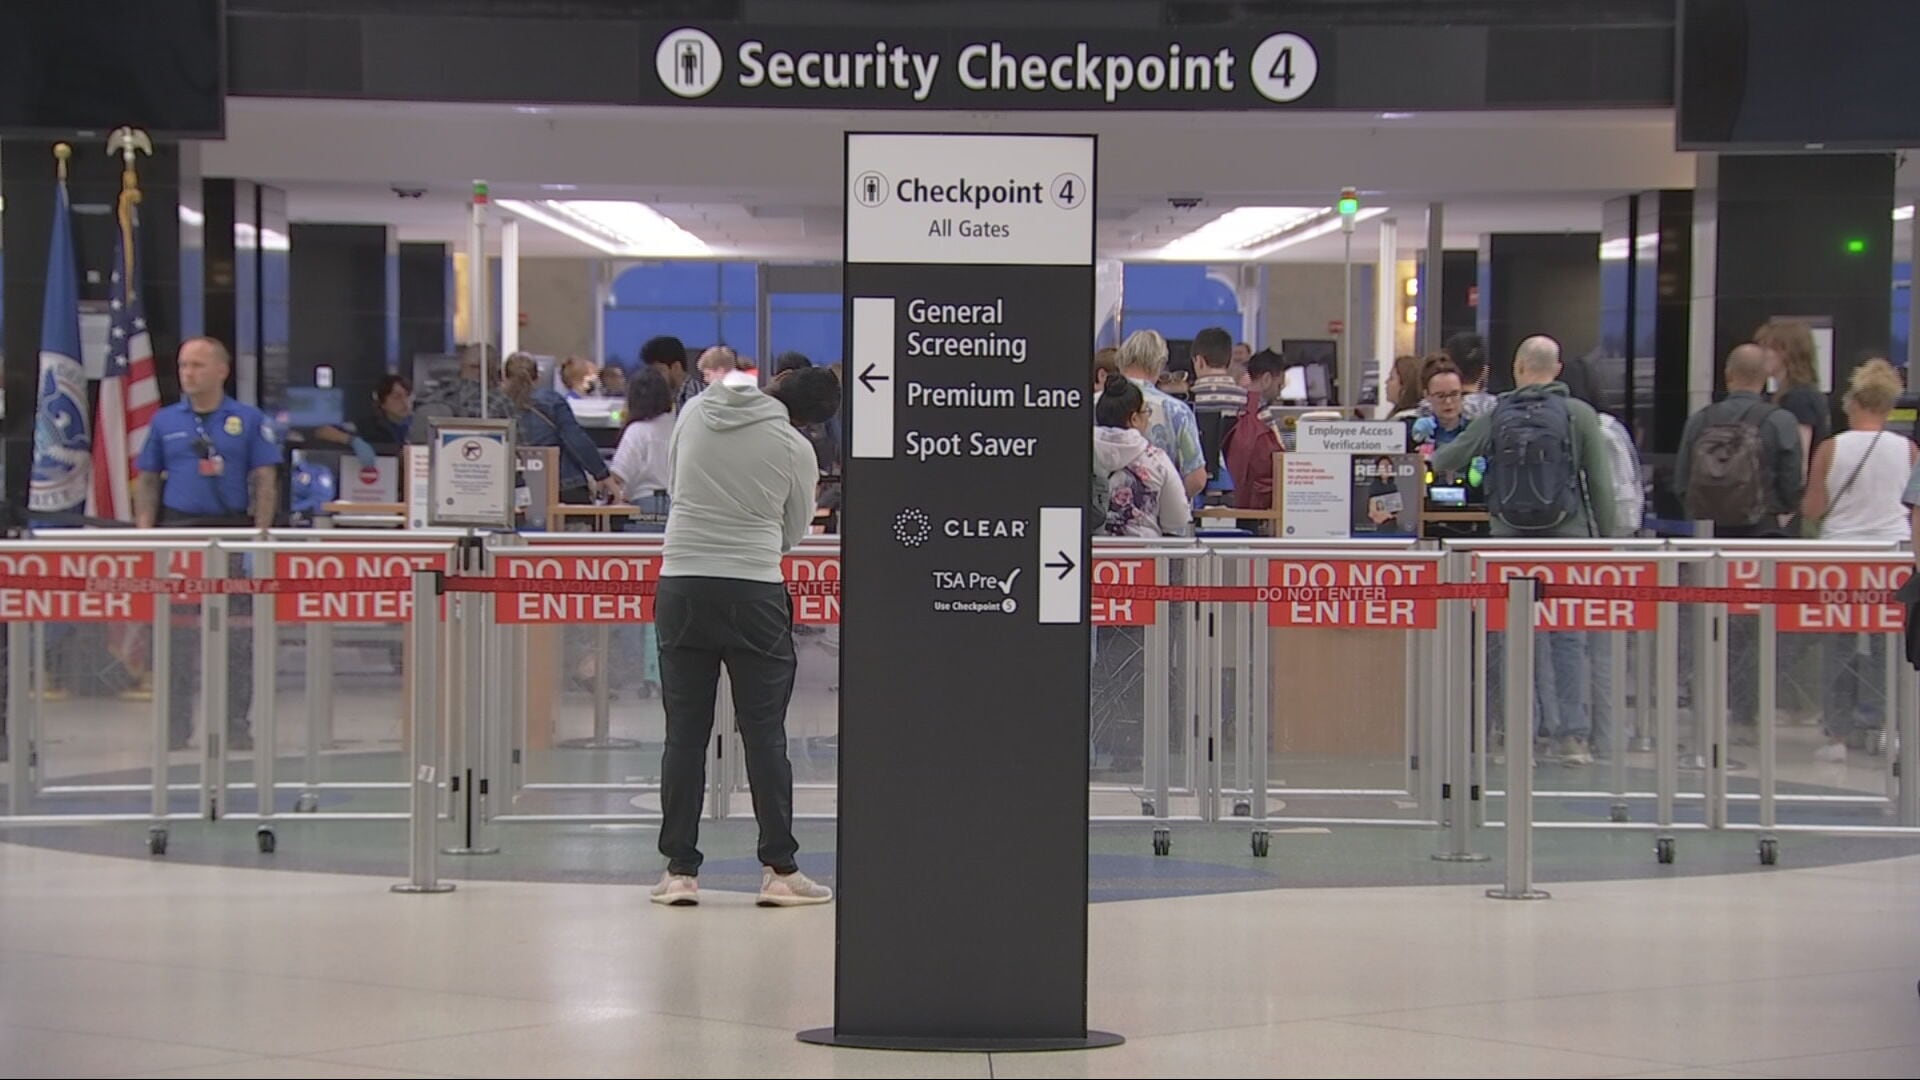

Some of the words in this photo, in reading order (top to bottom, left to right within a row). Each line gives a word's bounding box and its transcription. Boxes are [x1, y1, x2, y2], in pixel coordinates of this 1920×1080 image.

[738, 41, 939, 100] Security
[957, 44, 1234, 102] Checkpoint
[1268, 47, 1295, 88] 4
[896, 178, 1043, 209] Checkpoint
[1058, 179, 1075, 204] 4
[928, 219, 951, 237] All
[958, 219, 1010, 238] Gates
[908, 299, 1003, 324] General
[907, 332, 1027, 363] Screening
[907, 383, 1015, 407] Premium
[1024, 384, 1081, 408] Lane
[1308, 425, 1357, 437] Employee
[1359, 425, 1393, 436] Access
[905, 432, 961, 461] Spot
[969, 432, 1037, 456] Saver
[1323, 439, 1382, 450] Verification
[527, 459, 543, 471] ID
[1355, 465, 1397, 477] REAL
[1399, 465, 1415, 477] ID
[944, 520, 1025, 537] CLEAR
[60, 554, 142, 578] NOT
[289, 555, 344, 578] DO
[510, 558, 563, 580] DO
[576, 559, 652, 581] NOT
[1093, 561, 1142, 585] OT
[1283, 563, 1336, 587] DO
[1351, 564, 1425, 586] NOT
[1567, 565, 1645, 586] NOT
[1791, 566, 1847, 589] DO
[185, 579, 218, 593] EXIT
[221, 579, 263, 593] ONLY
[932, 572, 965, 589] TSA
[969, 572, 998, 589] Pre
[0, 590, 132, 617] ENTER
[1257, 587, 1282, 601] DO
[1288, 587, 1323, 601] NOT
[1328, 587, 1387, 600] ENTER
[1820, 591, 1847, 604] DO
[1852, 591, 1889, 604] NOT
[518, 593, 642, 619] ENTER
[934, 601, 950, 611] Use
[952, 601, 1000, 612] Checkpoint
[1534, 598, 1634, 626] NTER
[1800, 604, 1903, 628] ENTE
